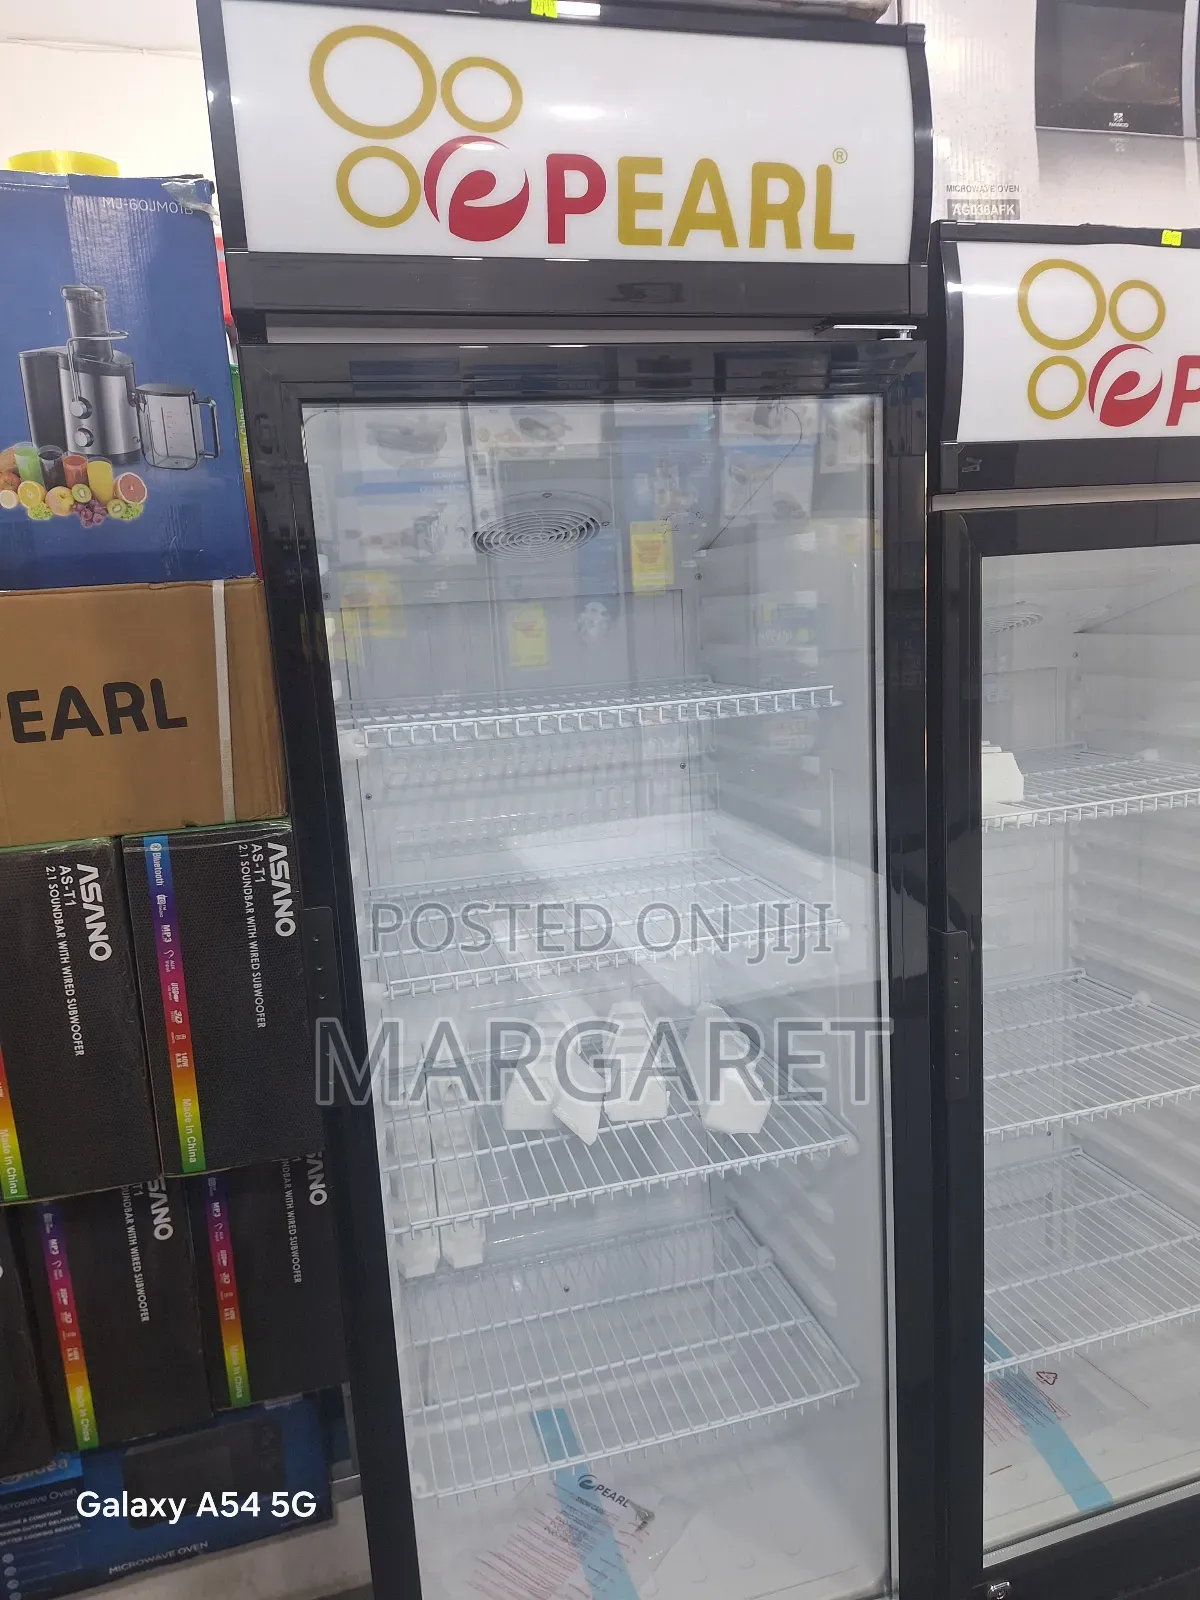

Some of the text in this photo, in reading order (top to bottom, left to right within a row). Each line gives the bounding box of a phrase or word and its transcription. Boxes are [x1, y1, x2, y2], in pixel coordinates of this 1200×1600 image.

[545, 153, 855, 251] PEARL
[946, 184, 1020, 193] MICROWAVE OVEN
[0, 678, 188, 744] EARL
[152, 852, 165, 886] Bluetooth
[251, 843, 266, 883] AS-T1
[59, 865, 77, 906] AS-T1
[268, 842, 296, 937] ASANO
[76, 863, 113, 962] ASANO
[162, 924, 172, 943] MP3
[239, 844, 266, 1029] 2.1 SOUNDBAR WITH WIRED SUBWOOFER
[45, 866, 85, 1057] 2.1 SOUNDBAR WITH WIRED SUBWOOFER
[183, 1098, 197, 1163] Made In China
[6, 1167, 18, 1194] China
[126, 1225, 138, 1245] WITH
[281, 1159, 302, 1284] NDBAR WITH WIRED SUBWOOFER
[130, 1246, 142, 1272] WIRED
[134, 1273, 150, 1322] SUBWOOFER
[594, 1484, 630, 1509] PEARL
[109, 1540, 209, 1575] MICROWAVE OVEN
